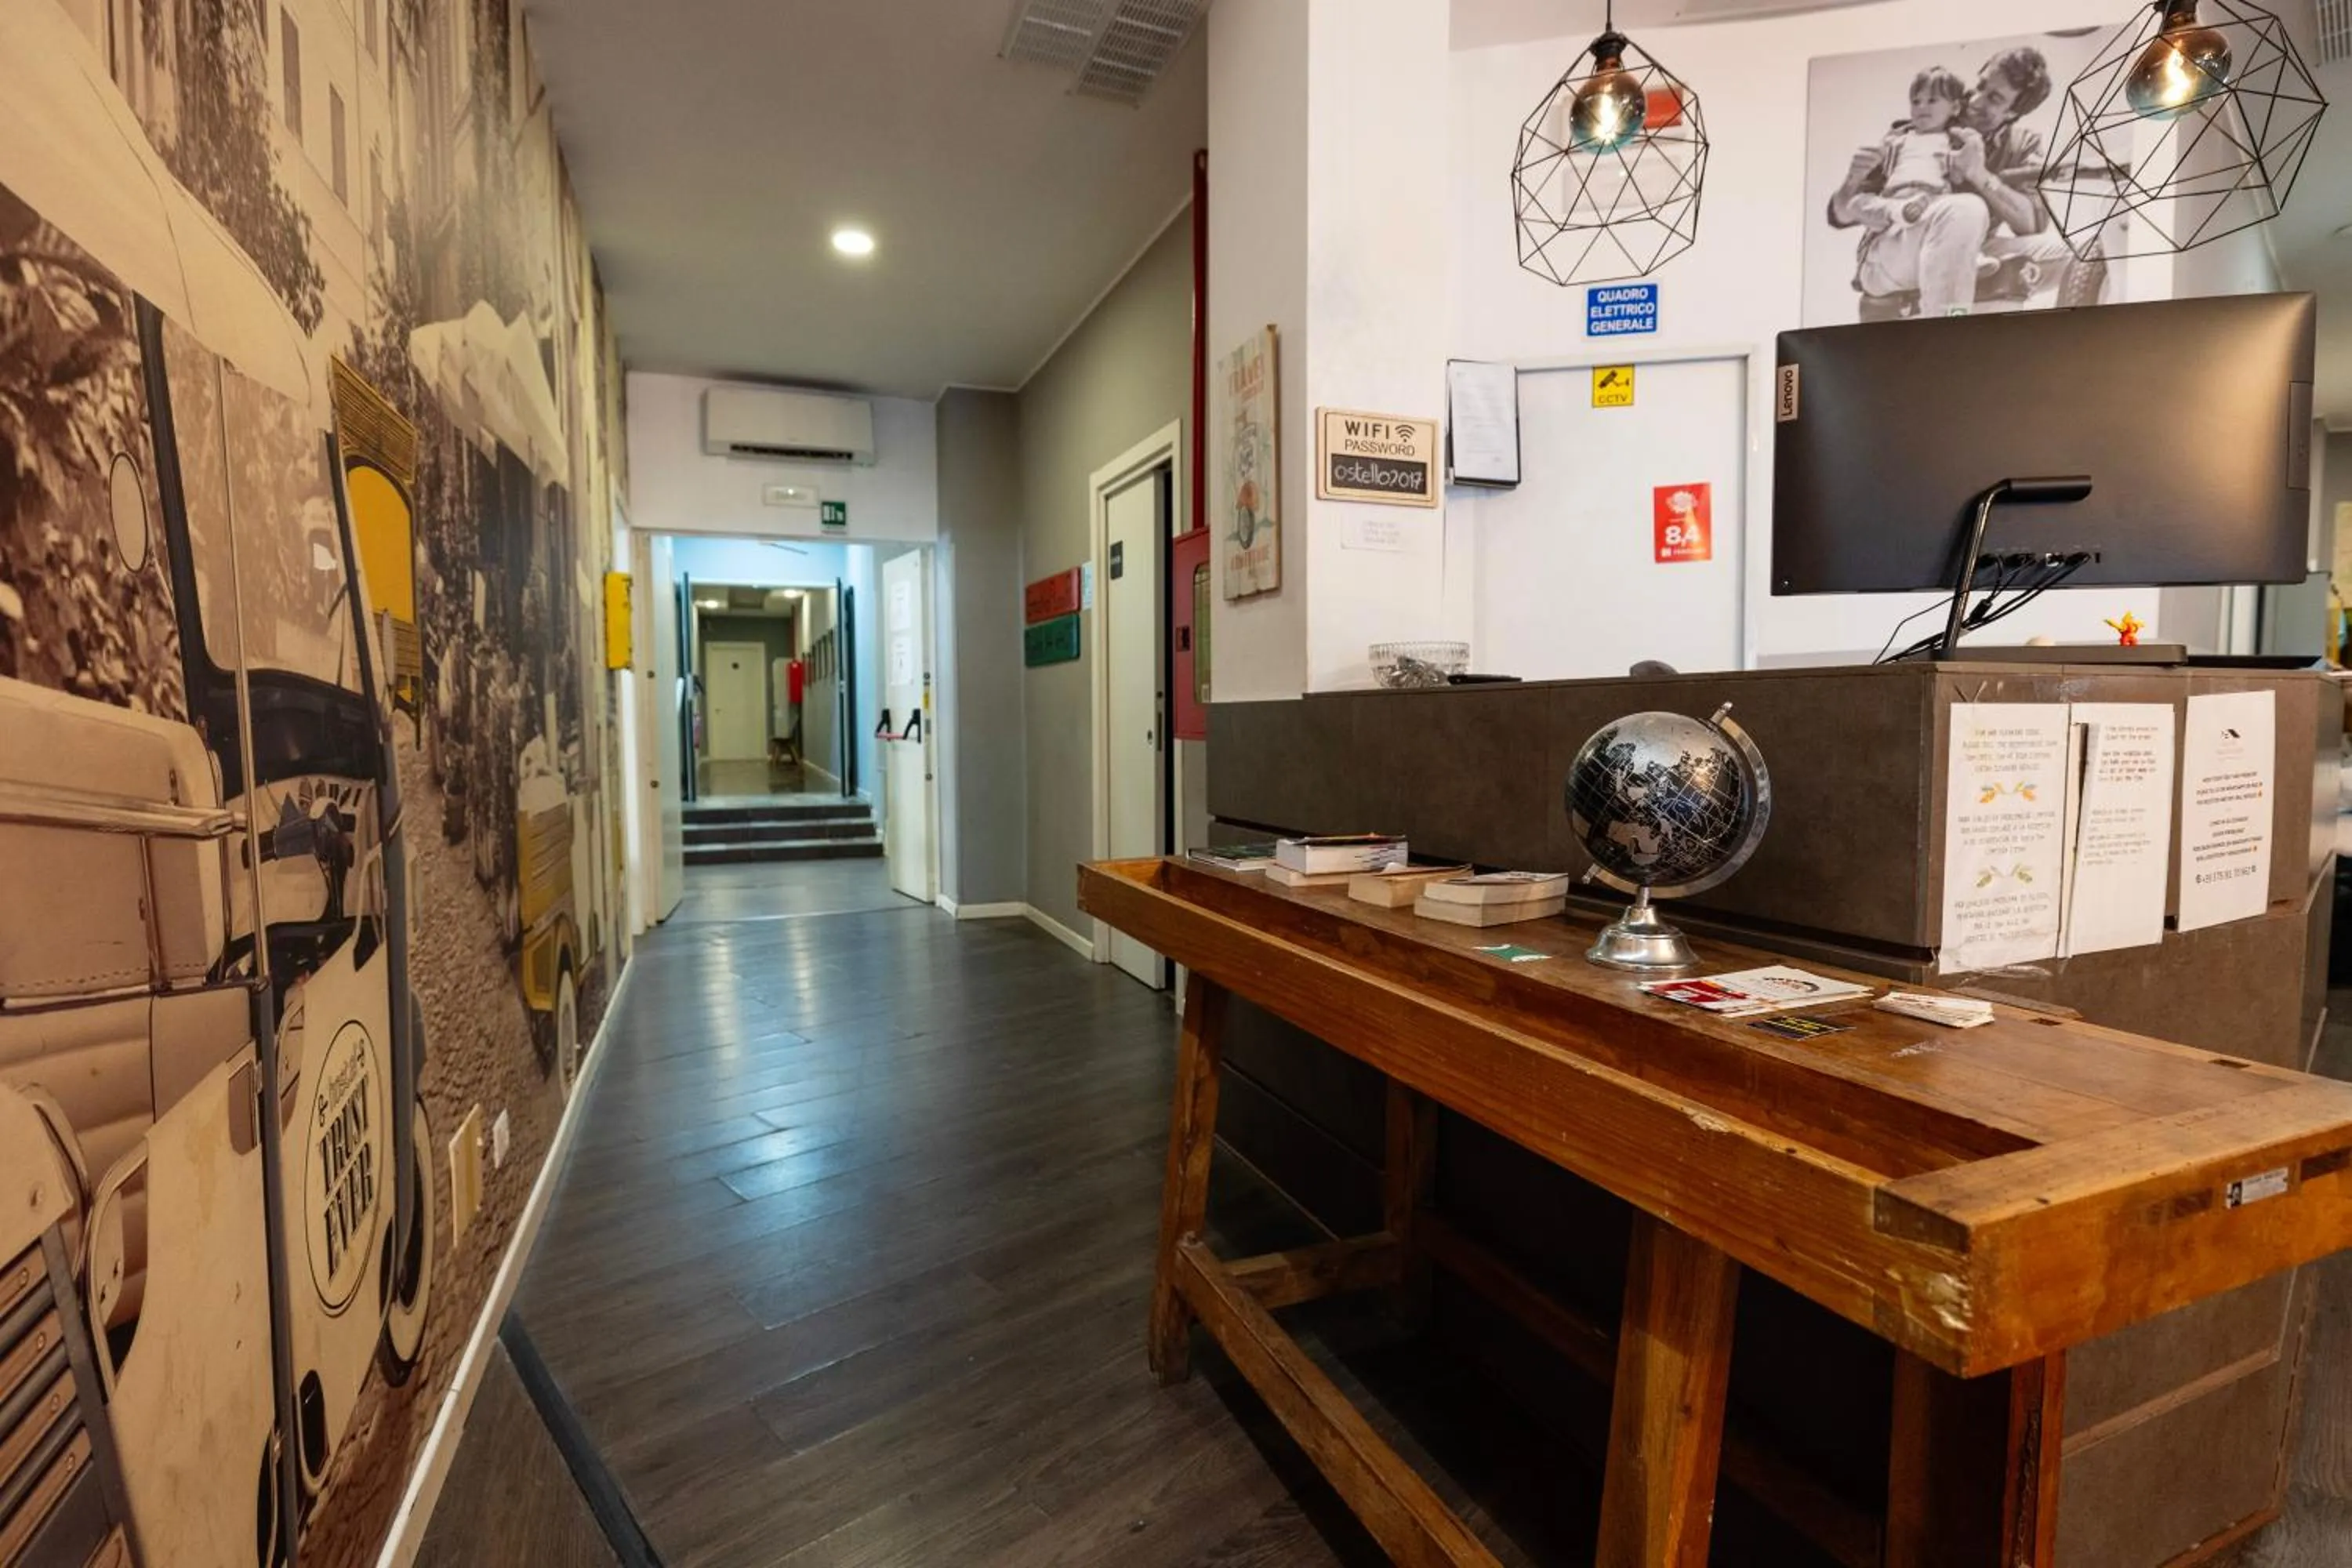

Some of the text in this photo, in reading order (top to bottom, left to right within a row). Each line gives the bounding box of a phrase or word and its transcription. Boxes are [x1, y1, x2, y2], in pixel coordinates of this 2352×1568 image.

[1597, 287, 1648, 304] QUADRO
[1590, 303, 1654, 318] ELETTRICO
[1591, 318, 1653, 334] GENERALE
[1598, 394, 1628, 405] CCTV
[1781, 369, 1794, 418] Lenovo
[1345, 419, 1390, 441] WIFI
[1345, 438, 1415, 457] PASSWORD
[318, 1071, 370, 1200] TRUST
[325, 1142, 372, 1286] EVER
